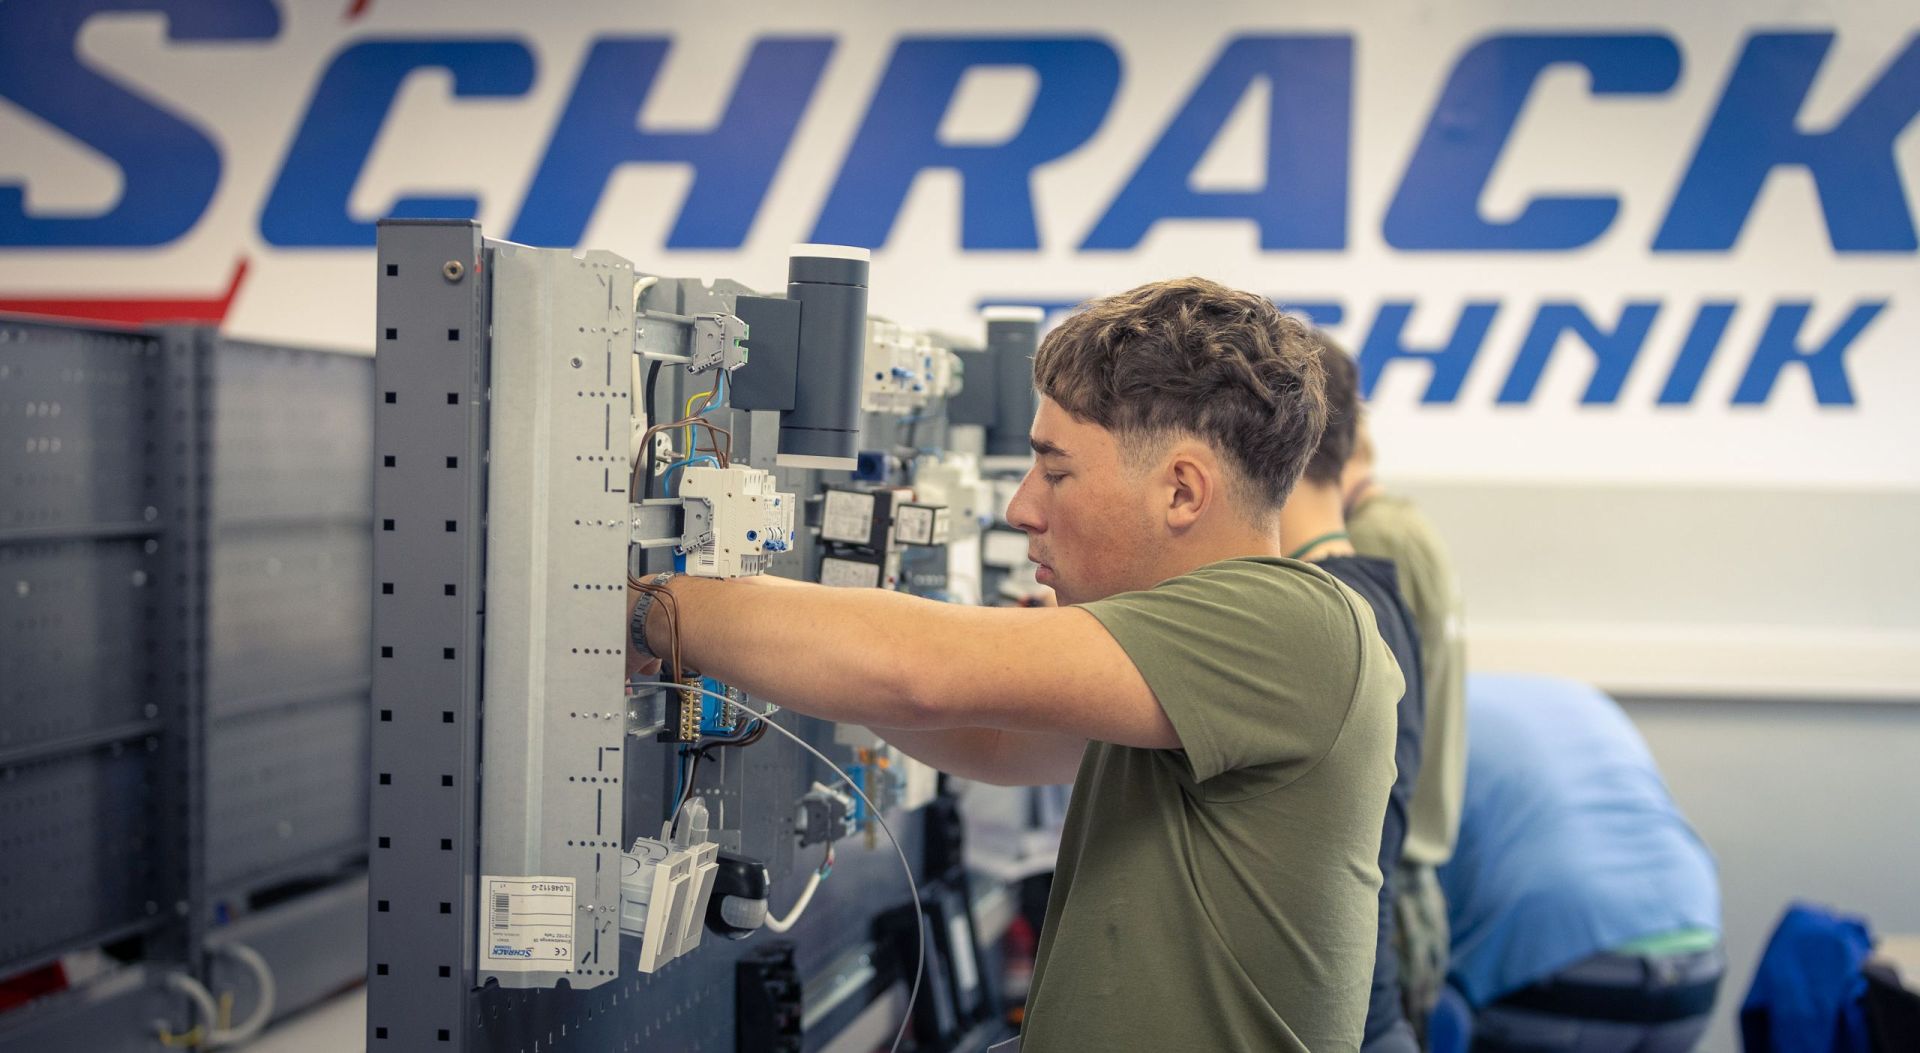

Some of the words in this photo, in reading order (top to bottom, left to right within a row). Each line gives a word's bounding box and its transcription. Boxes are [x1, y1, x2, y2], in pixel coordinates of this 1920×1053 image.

[0, 0, 1920, 252] SCHRACK
[977, 299, 1888, 406] HNIK
[492, 948, 532, 958] SCHRACK
